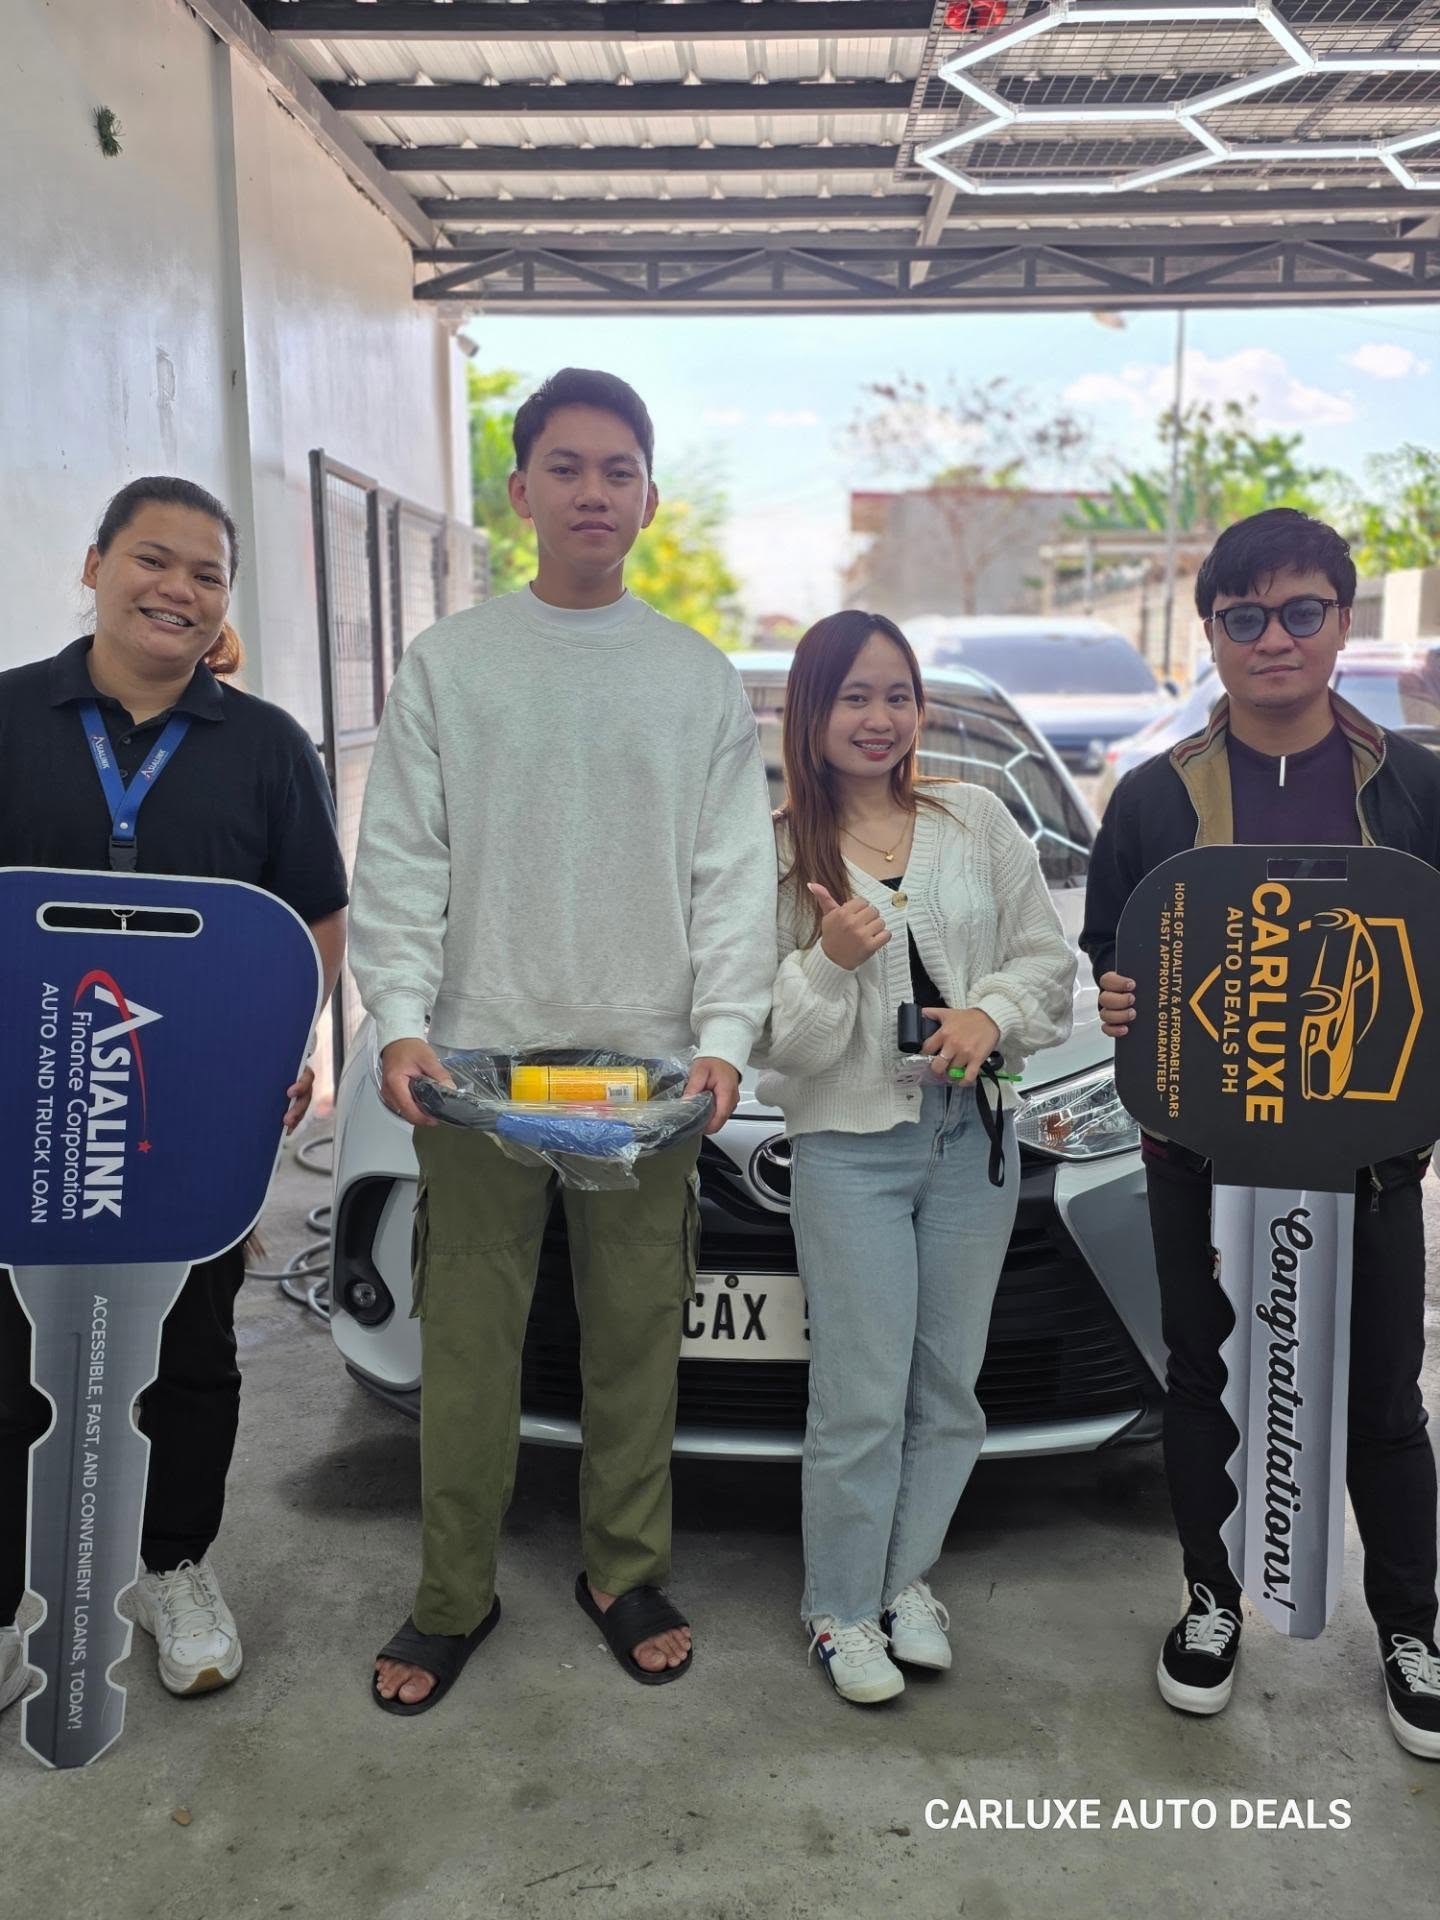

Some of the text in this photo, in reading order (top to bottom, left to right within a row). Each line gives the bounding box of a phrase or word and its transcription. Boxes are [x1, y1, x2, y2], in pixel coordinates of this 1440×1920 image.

[1158, 944, 1170, 1008] APPROVAL
[1168, 882, 1185, 1118] HOME OF QUALITY & AFFORDABLE CARS
[1221, 906, 1243, 1093] AUTO DEALS PH
[1245, 882, 1291, 1124] CARLUXE
[30, 982, 59, 1223] AUTO AND TRUCK LOAN
[60, 1011, 93, 1220] Finance Corporation
[82, 984, 164, 1220] ASIALINK
[682, 1293, 767, 1340] CAX
[1256, 1207, 1315, 1613] Congratulations!
[66, 1295, 108, 1730] ACCESSIBLE, FAST, AND CONVENIENT LOANS, TODAY!
